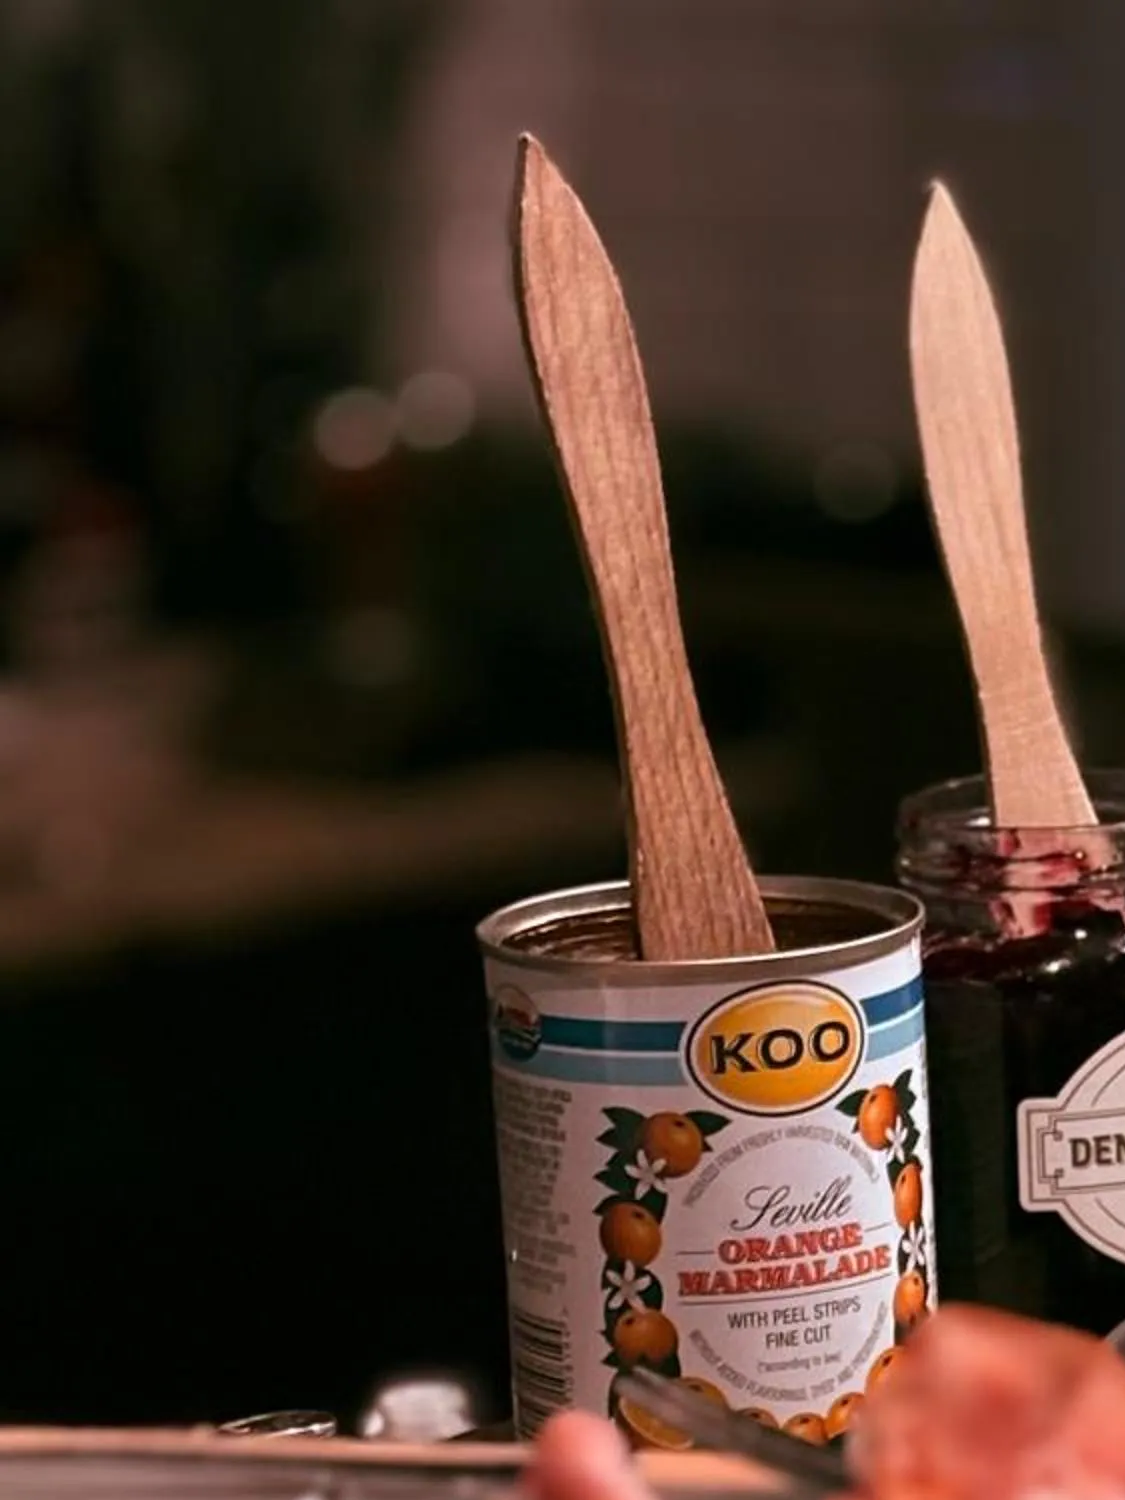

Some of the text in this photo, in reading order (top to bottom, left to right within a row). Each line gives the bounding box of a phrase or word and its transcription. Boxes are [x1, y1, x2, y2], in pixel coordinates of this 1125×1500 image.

[710, 1020, 851, 1075] KOO
[729, 1175, 853, 1232] Seville
[717, 1221, 864, 1266] ORANGE
[677, 1243, 892, 1296] MARMALADE
[726, 1295, 862, 1330] WITH PEEL STRIPS
[765, 1324, 833, 1350] FINE CUT
